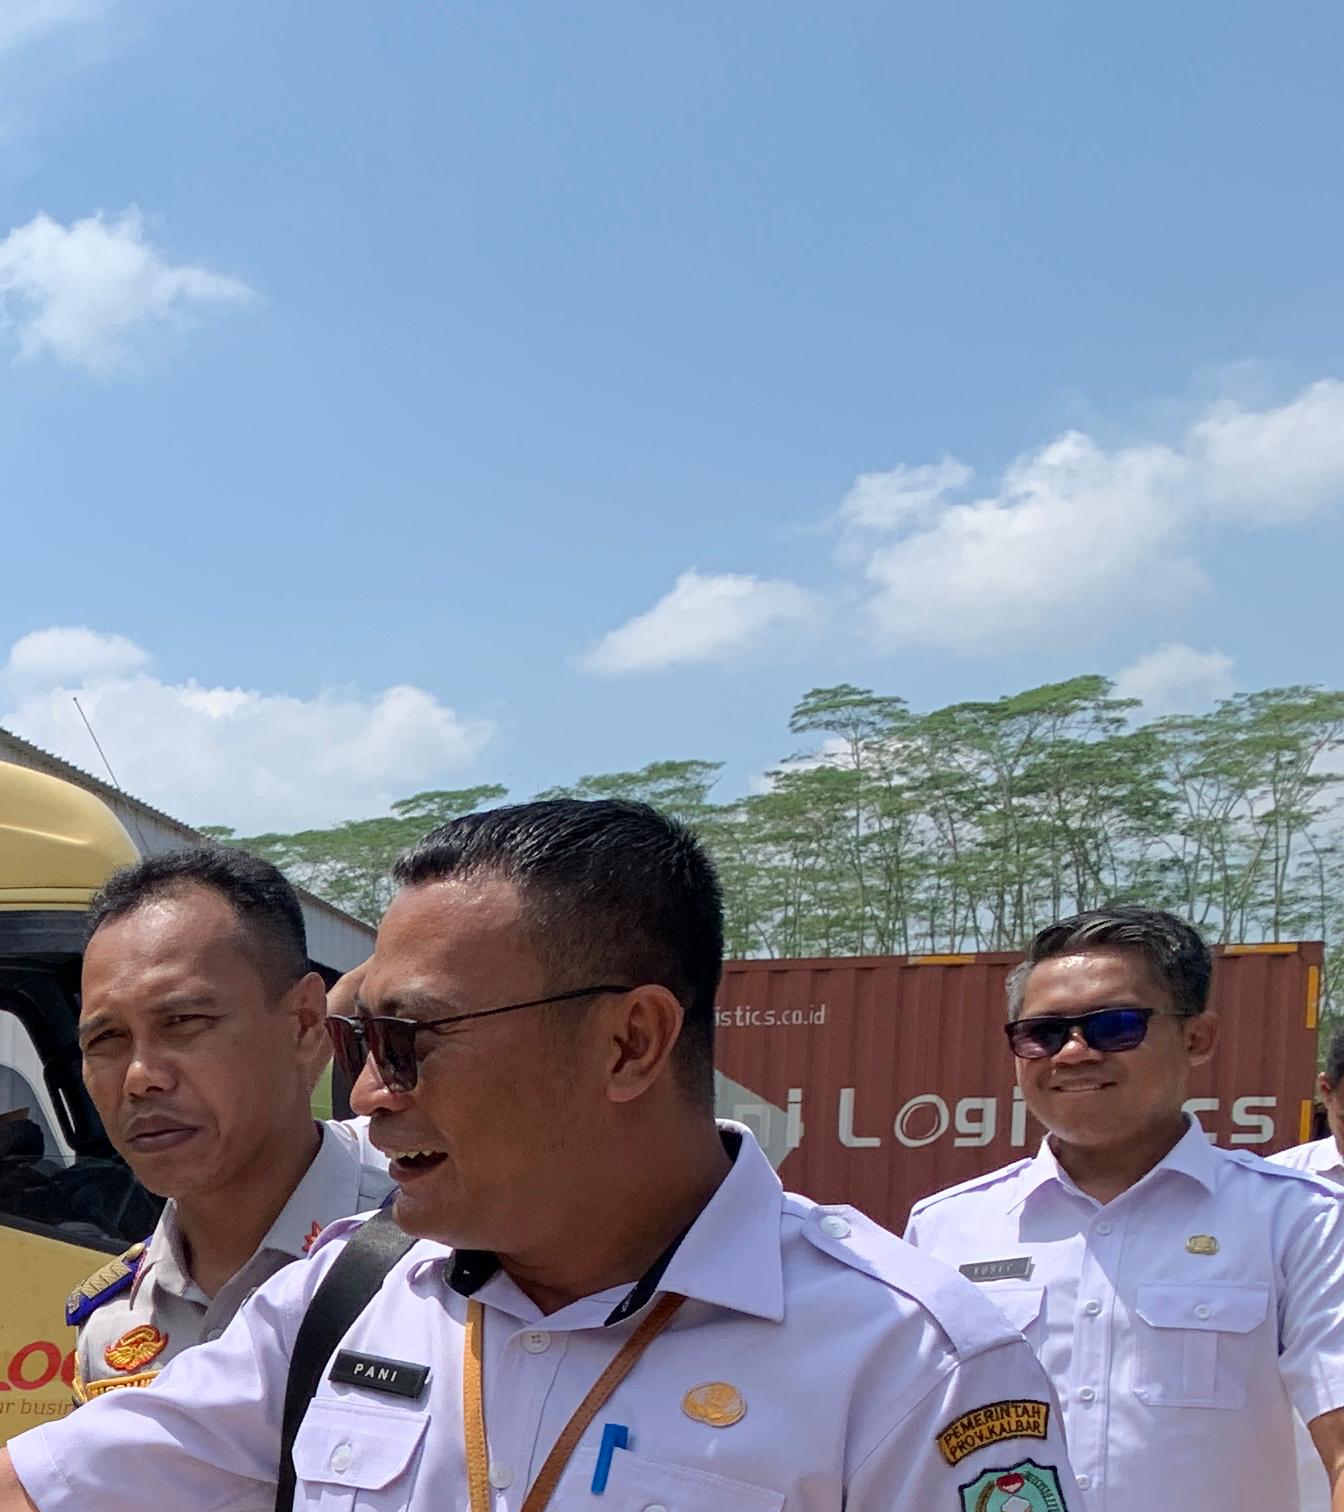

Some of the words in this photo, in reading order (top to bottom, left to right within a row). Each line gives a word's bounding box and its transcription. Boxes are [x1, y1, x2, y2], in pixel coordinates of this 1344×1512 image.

[714, 1004, 827, 1027] istics.co.id
[354, 1363, 398, 1382] PANI
[943, 1405, 1041, 1447] PEMERINTAH
